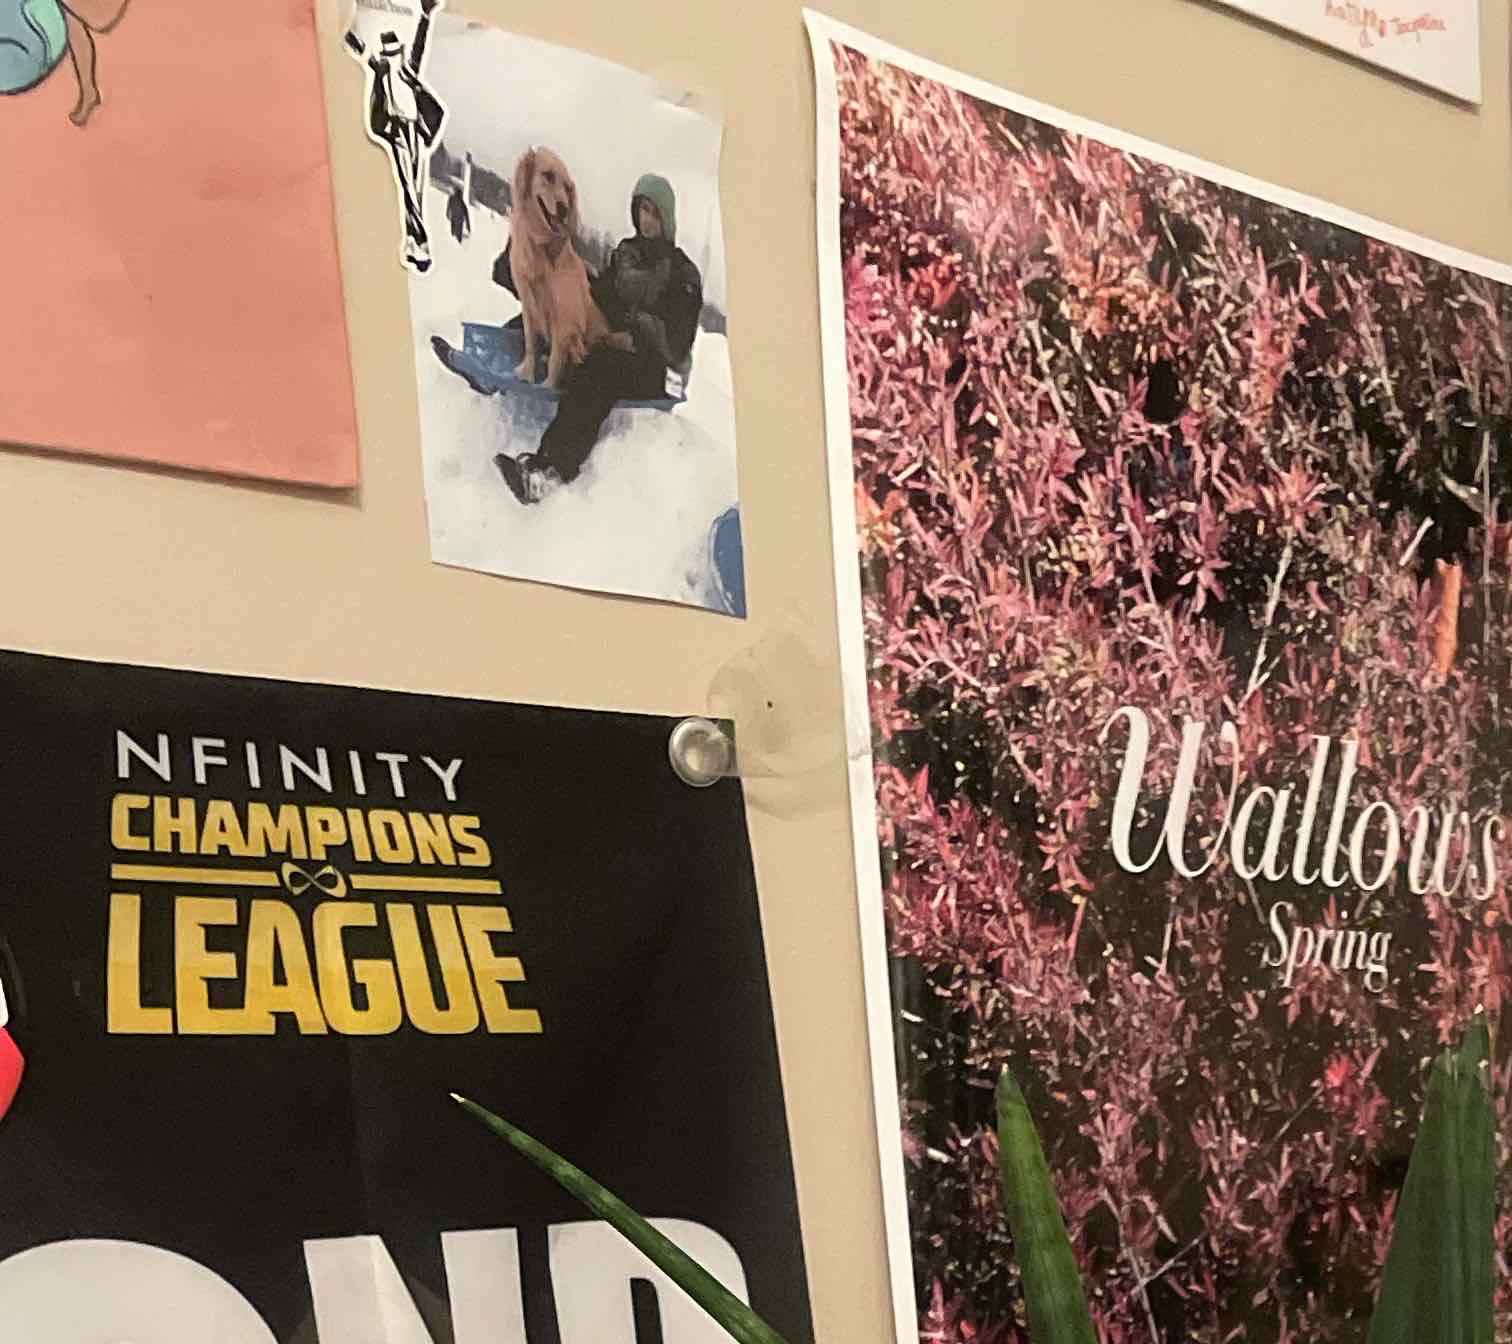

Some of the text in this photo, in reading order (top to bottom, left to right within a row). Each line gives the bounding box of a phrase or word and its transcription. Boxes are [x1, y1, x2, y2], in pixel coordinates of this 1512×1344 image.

[115, 729, 464, 802] NFINITY
[1097, 705, 1506, 901] Wallows
[110, 792, 492, 868] CHAMPIONS
[106, 892, 545, 1036] LEAGUE
[1262, 900, 1393, 994] Spring
